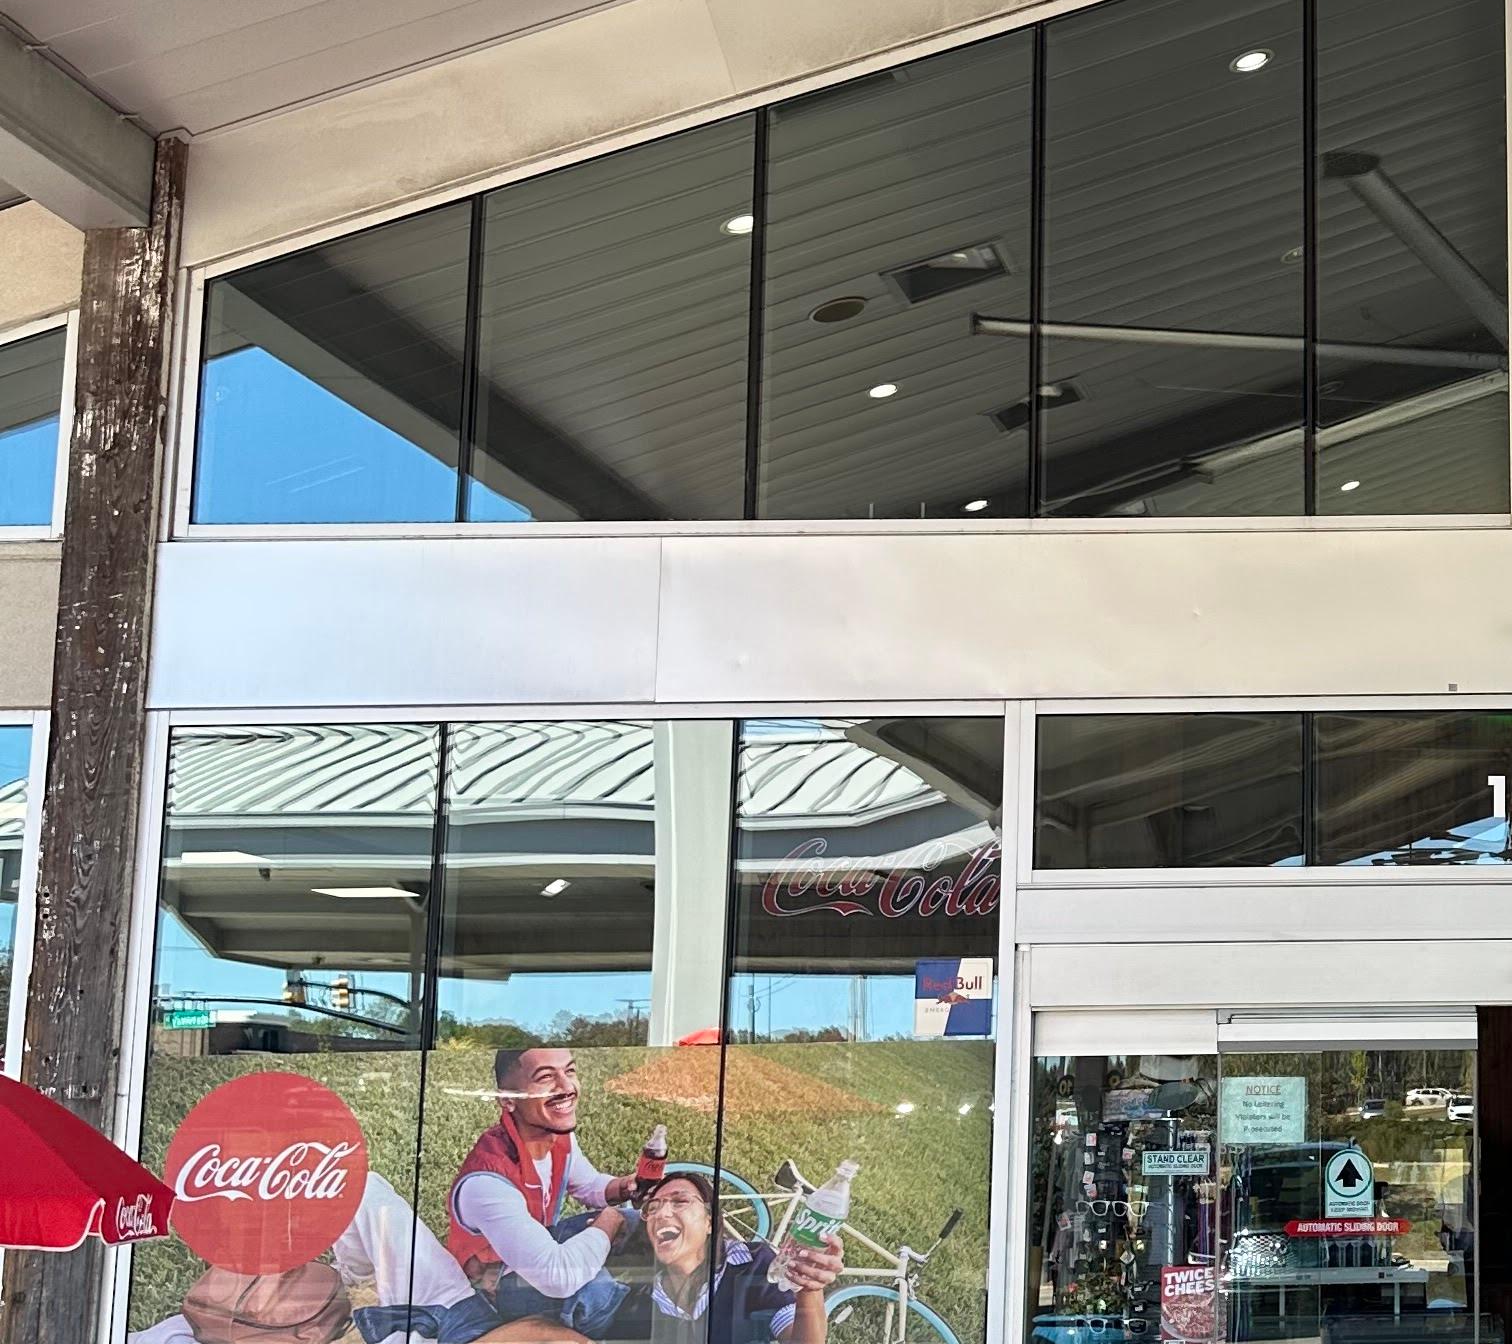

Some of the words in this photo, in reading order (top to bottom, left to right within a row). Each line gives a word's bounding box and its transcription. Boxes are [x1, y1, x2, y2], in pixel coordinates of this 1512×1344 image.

[955, 975, 983, 990] Bull
[1245, 1084, 1282, 1095] NOTICE
[1146, 1154, 1175, 1164] STAND
[1176, 1154, 1205, 1164] CLEAR
[174, 1141, 361, 1202] Coca-Cola
[795, 1208, 842, 1233] Sprit
[1297, 1222, 1343, 1233] AUTOMATIC
[1343, 1222, 1375, 1232] SLIDING
[1376, 1221, 1400, 1232] DOOR
[1163, 1267, 1214, 1286] TWICE
